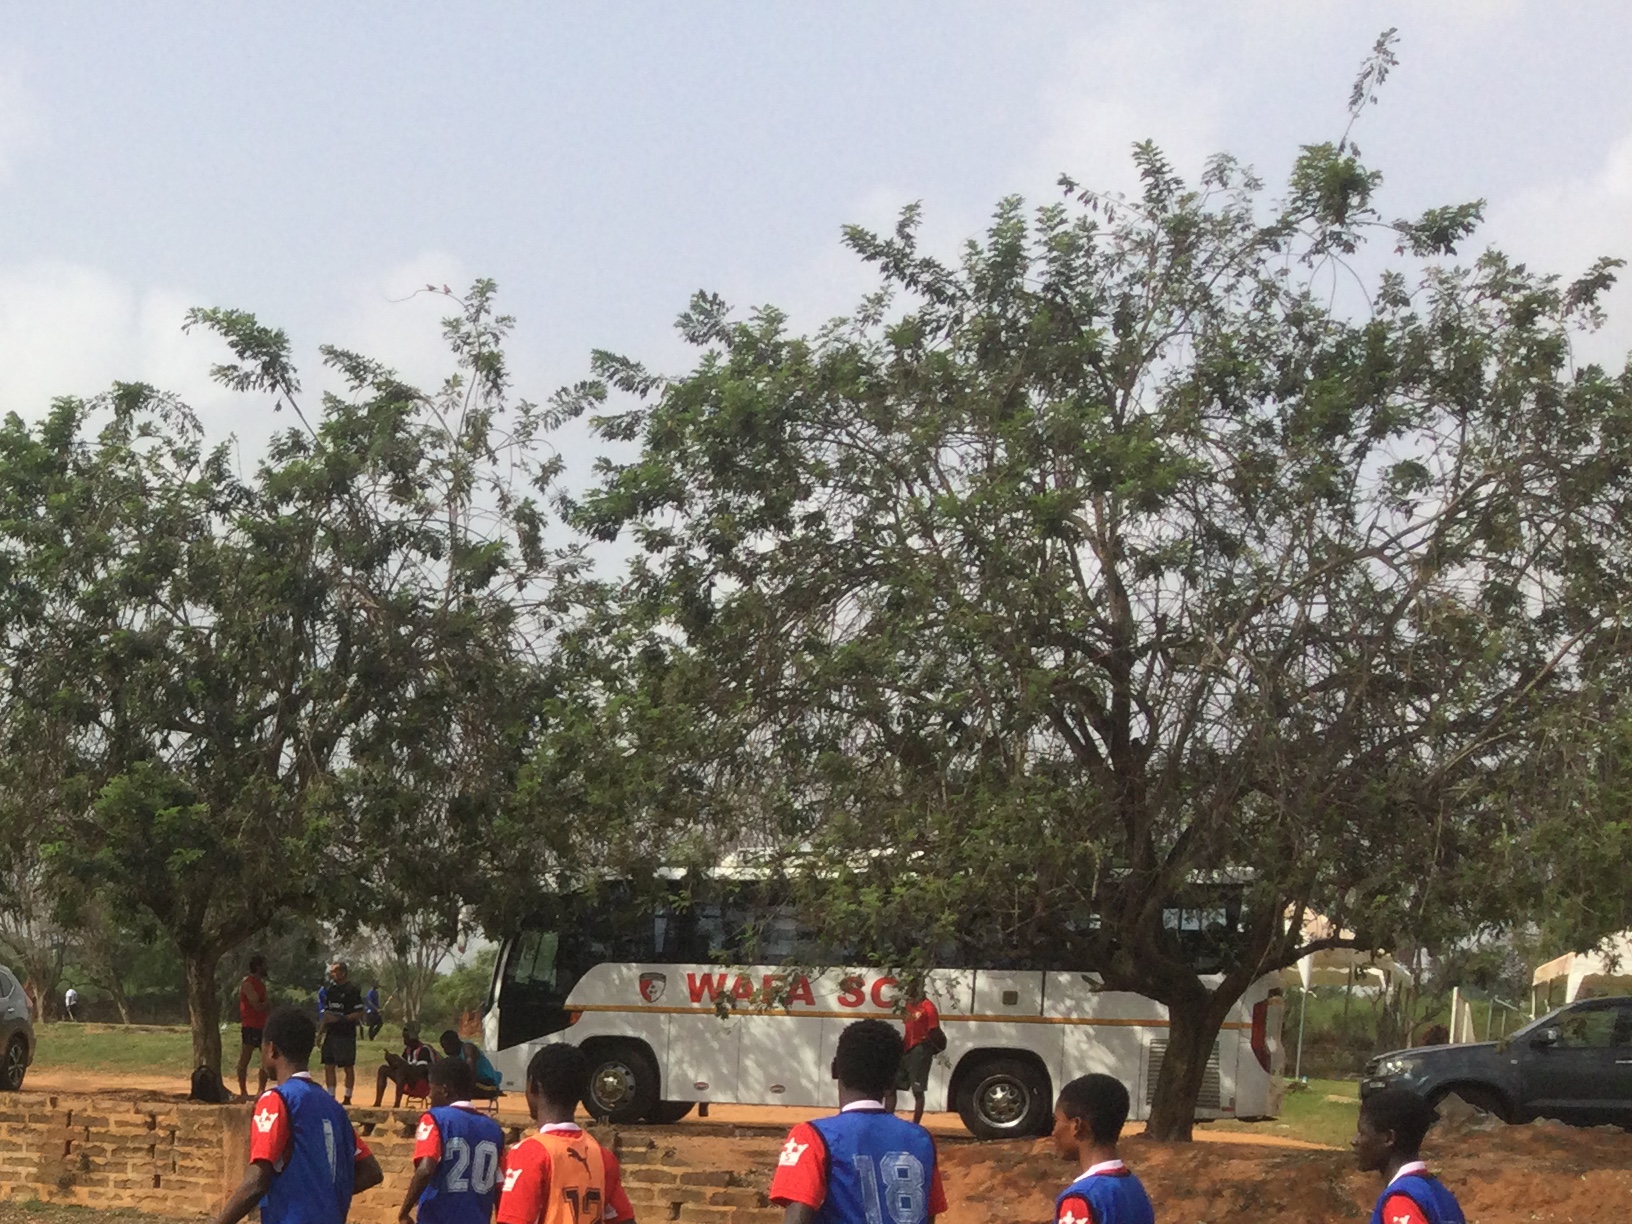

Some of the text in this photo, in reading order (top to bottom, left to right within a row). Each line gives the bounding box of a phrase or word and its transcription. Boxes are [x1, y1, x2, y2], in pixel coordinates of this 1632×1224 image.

[687, 972, 897, 1008] WAFA SC
[446, 1136, 498, 1194] 20
